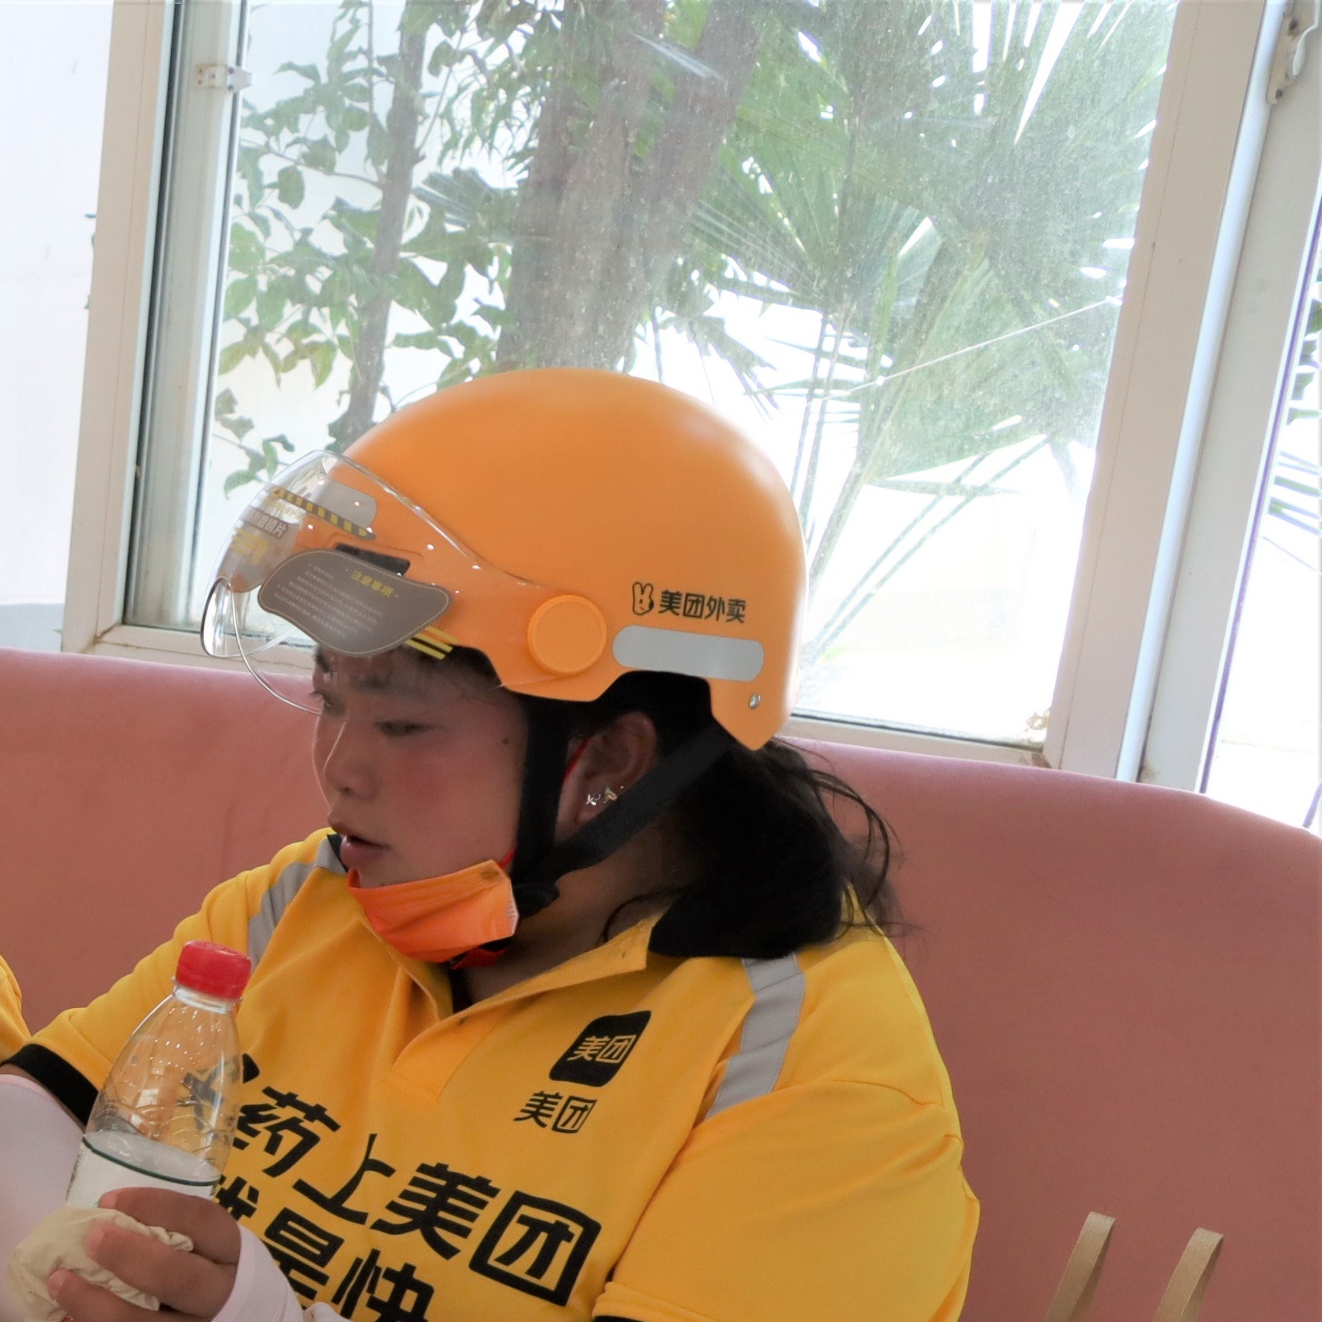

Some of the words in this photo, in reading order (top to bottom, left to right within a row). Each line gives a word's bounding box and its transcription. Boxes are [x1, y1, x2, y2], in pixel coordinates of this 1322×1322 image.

[658, 589, 746, 624] 美团外卖
[572, 1027, 635, 1067] 美团
[514, 1090, 598, 1134] 美团
